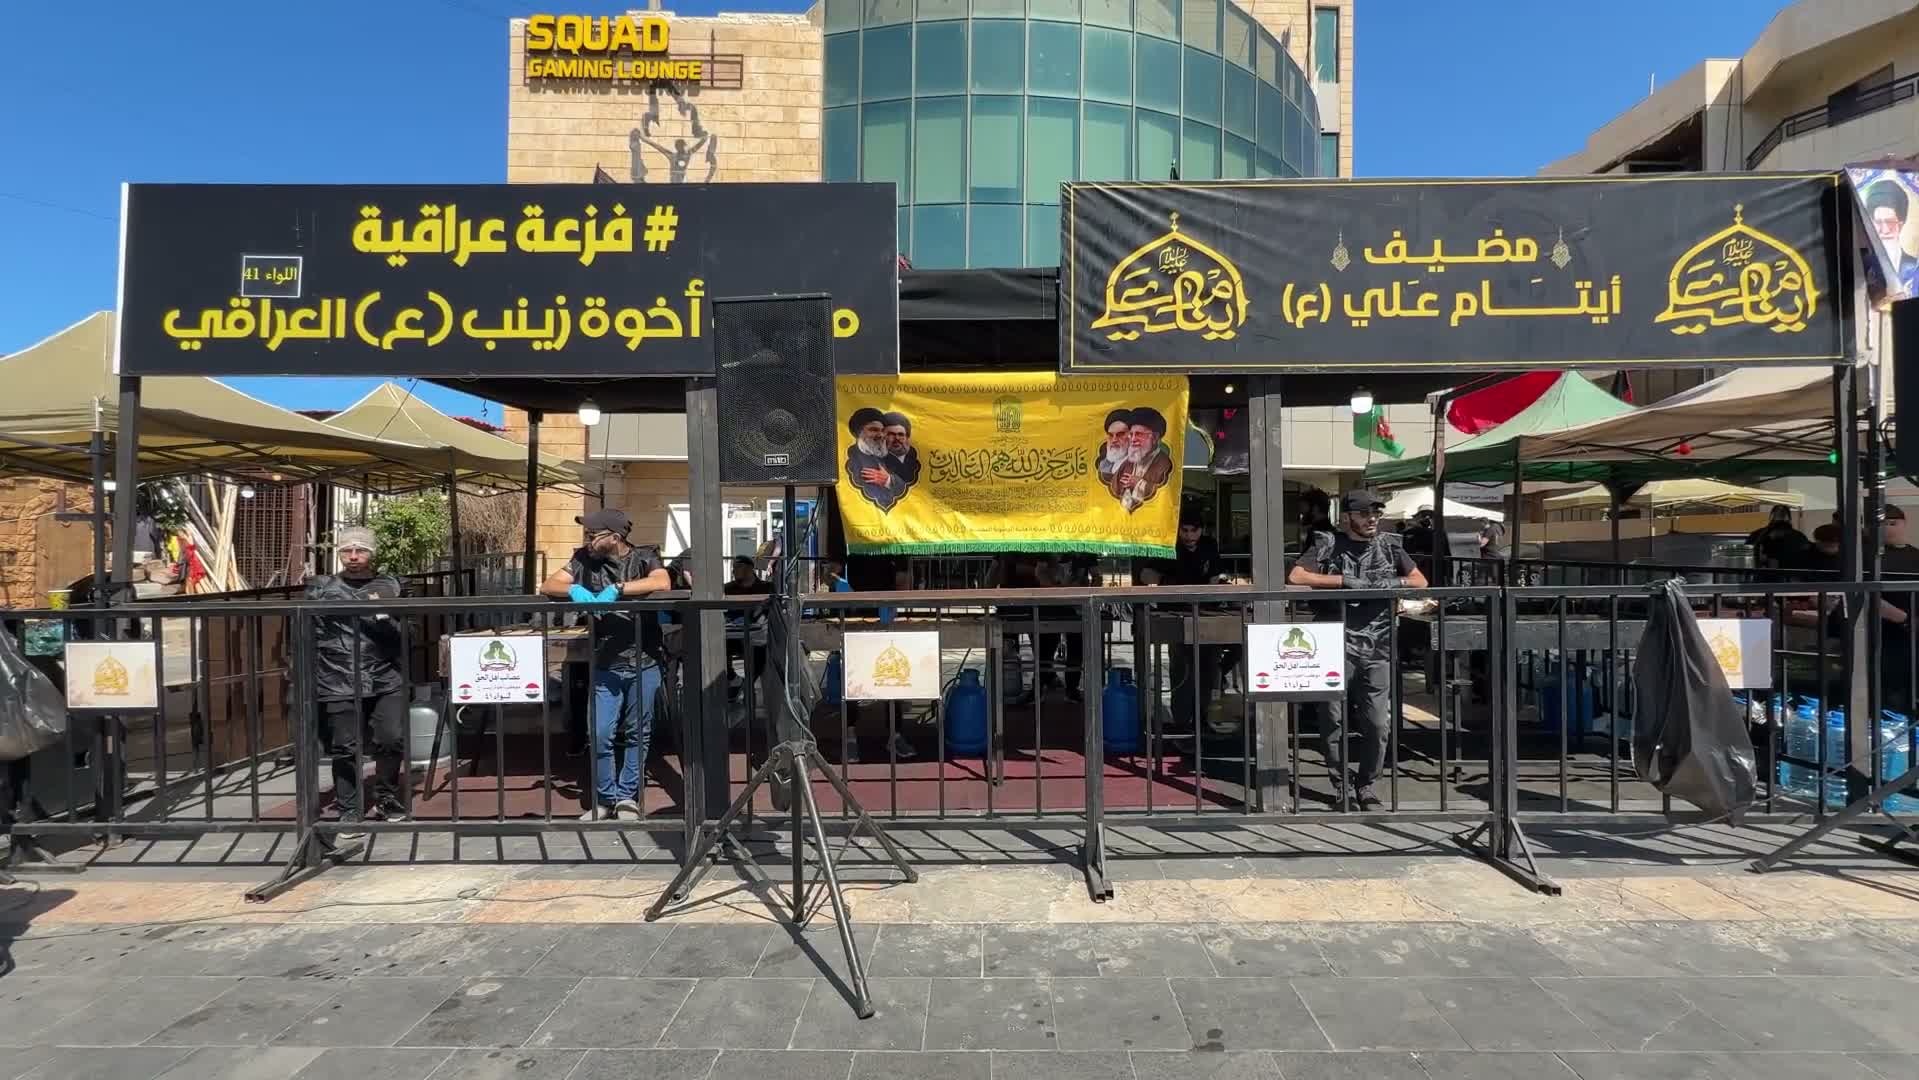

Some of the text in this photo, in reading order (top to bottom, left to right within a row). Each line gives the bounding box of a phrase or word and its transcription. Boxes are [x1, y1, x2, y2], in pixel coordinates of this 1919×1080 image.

[526, 14, 671, 54] SQUAD
[527, 59, 704, 80] GAMING LOUNGE
[352, 203, 507, 268] عراقية
[515, 203, 633, 267] فزعة
[1363, 229, 1539, 273] مضيف
[243, 266, 298, 285] اللواء 41
[163, 297, 347, 352] العراقي
[462, 295, 572, 352] زينب
